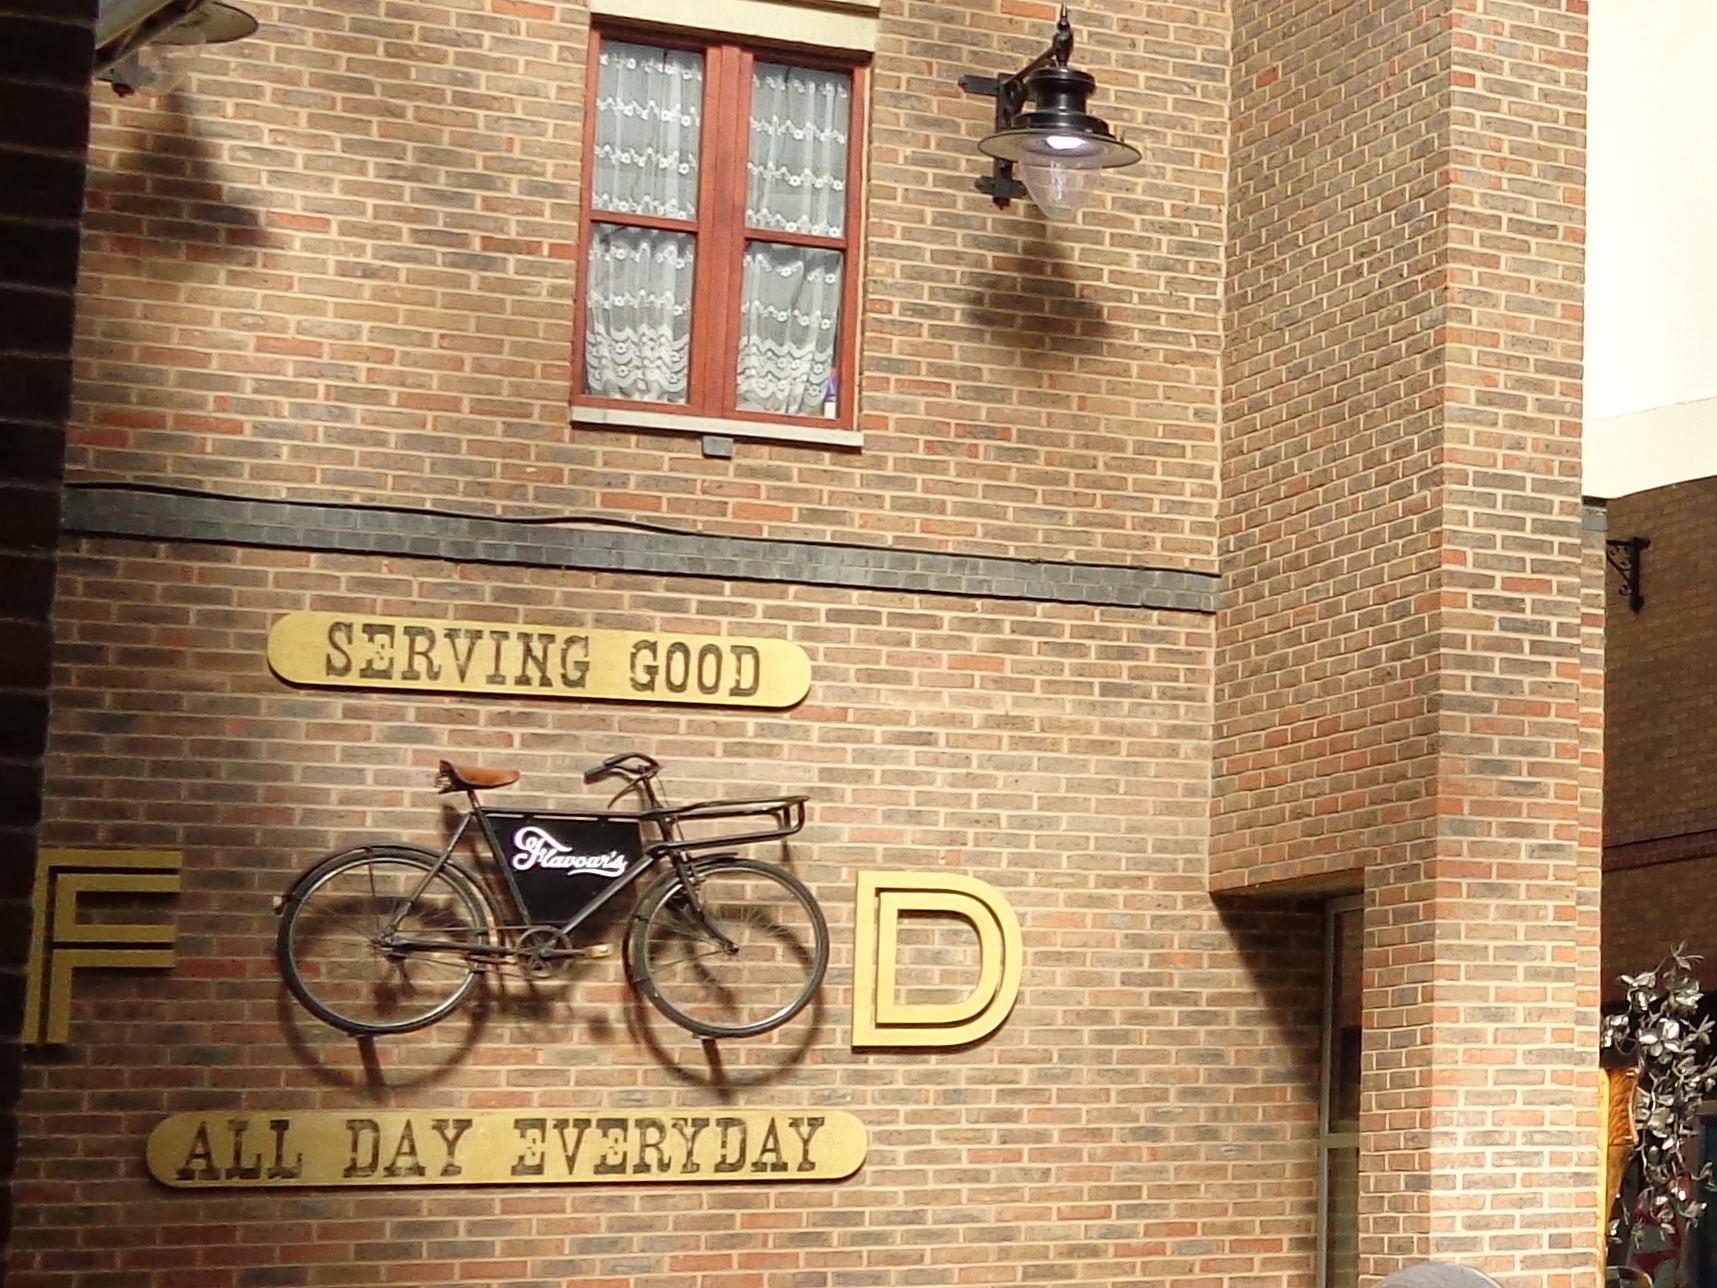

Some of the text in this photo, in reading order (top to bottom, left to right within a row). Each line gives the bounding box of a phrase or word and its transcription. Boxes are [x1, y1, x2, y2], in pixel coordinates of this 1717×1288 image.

[325, 620, 761, 698] SERVING GOOD
[176, 1116, 827, 1181] ALL DAY EVERYDAY
